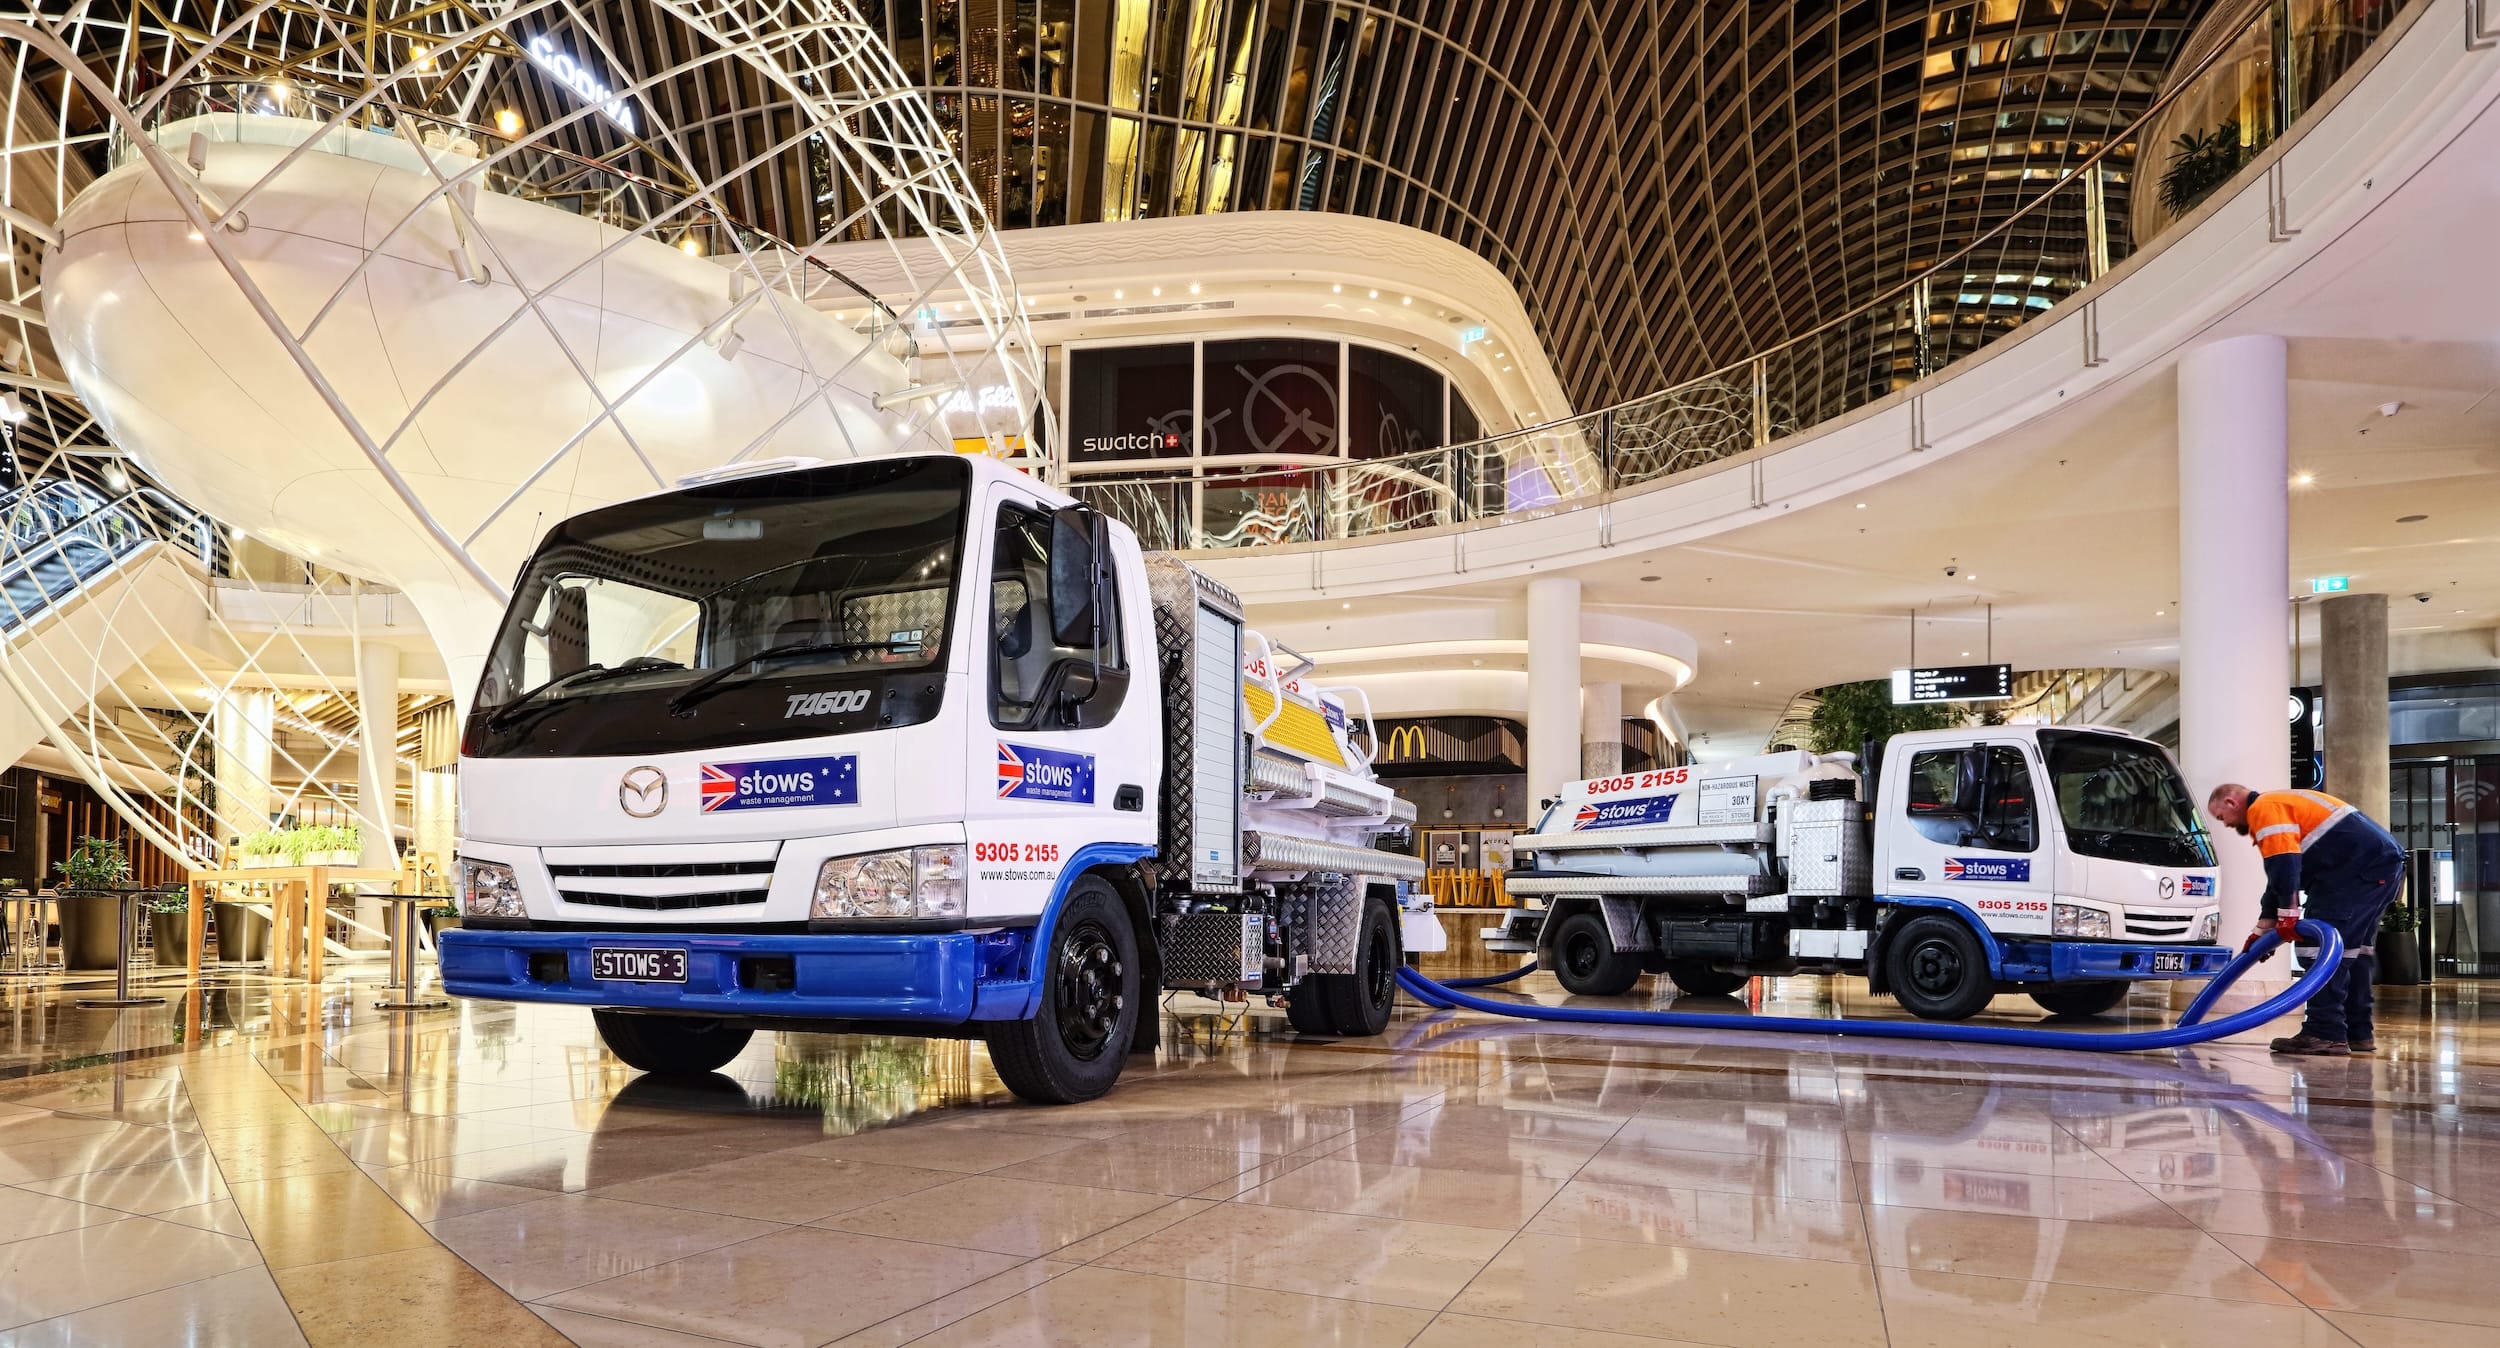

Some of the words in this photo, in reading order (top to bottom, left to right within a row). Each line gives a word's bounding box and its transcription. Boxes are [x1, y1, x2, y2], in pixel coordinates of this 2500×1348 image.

[1083, 432, 1163, 452] swatch
[784, 690, 871, 718] T4600
[1026, 758, 1072, 787] stows
[739, 769, 814, 795] stows
[1587, 776, 1635, 795] 9305
[1641, 769, 1689, 788] 2155
[1739, 780, 1754, 788] WASTE
[740, 797, 762, 805] waste
[764, 794, 814, 805] management
[1026, 787, 1040, 795] waste
[1042, 788, 1072, 799] management
[1599, 803, 1648, 820] stows
[975, 843, 1019, 862] 9305
[1025, 844, 1059, 862] 2155
[980, 868, 1056, 881] www.stows.com.au
[1965, 862, 2007, 875] stows
[1977, 901, 2011, 909] 9305
[2016, 902, 2048, 911] 2155
[1981, 911, 2044, 920] www.stows.com.au
